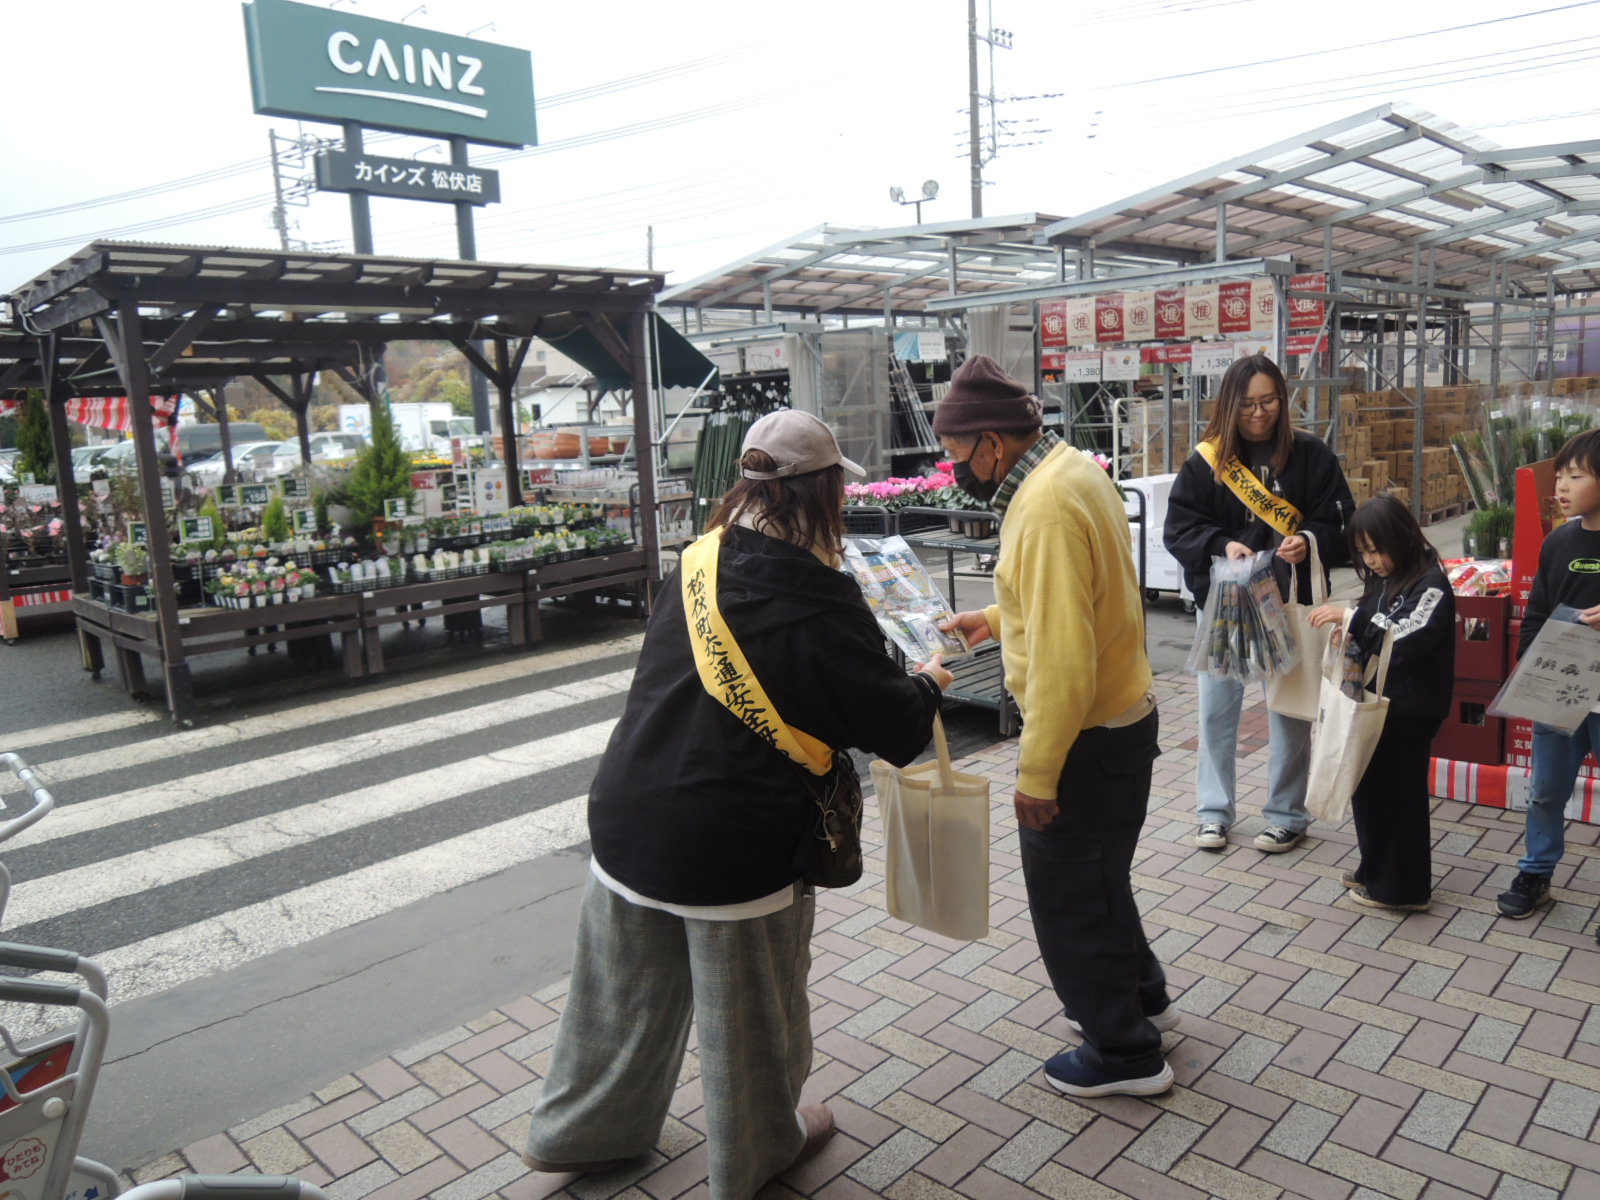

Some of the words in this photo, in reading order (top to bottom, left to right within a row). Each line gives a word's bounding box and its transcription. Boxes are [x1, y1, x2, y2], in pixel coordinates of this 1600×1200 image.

[327, 31, 485, 96] CAINZ
[354, 161, 425, 187] カインズ
[431, 170, 483, 194] 松伏店
